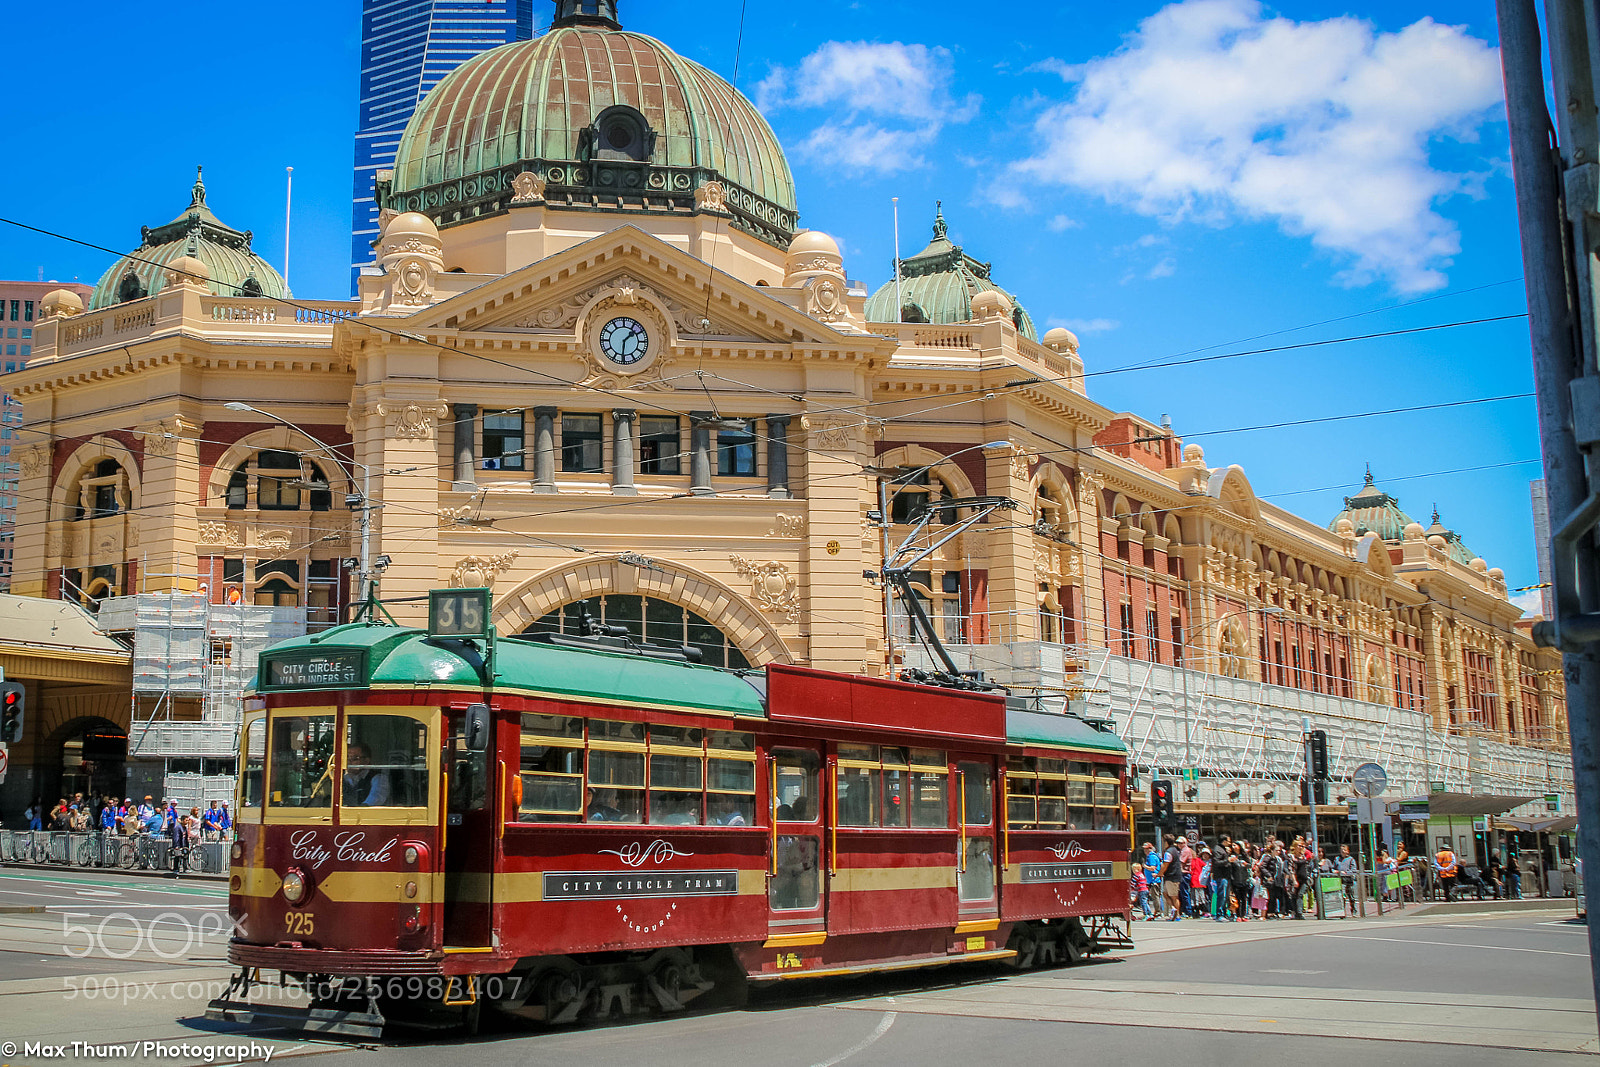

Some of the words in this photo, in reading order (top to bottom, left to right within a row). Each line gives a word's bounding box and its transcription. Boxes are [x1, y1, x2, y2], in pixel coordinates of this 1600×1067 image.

[439, 597, 479, 629] 35
[282, 664, 304, 674] CITY
[308, 662, 341, 673] CIRCLE
[279, 676, 294, 684] VIA
[298, 674, 340, 684] FLINDERS
[343, 673, 355, 682] ST
[290, 830, 331, 870] City
[333, 831, 398, 863] Circle
[1053, 868, 1082, 876] CIRCLE
[562, 881, 603, 891] CITY
[616, 880, 673, 890] CIRCLE
[685, 879, 722, 888] TRAM
[285, 911, 314, 935] 925
